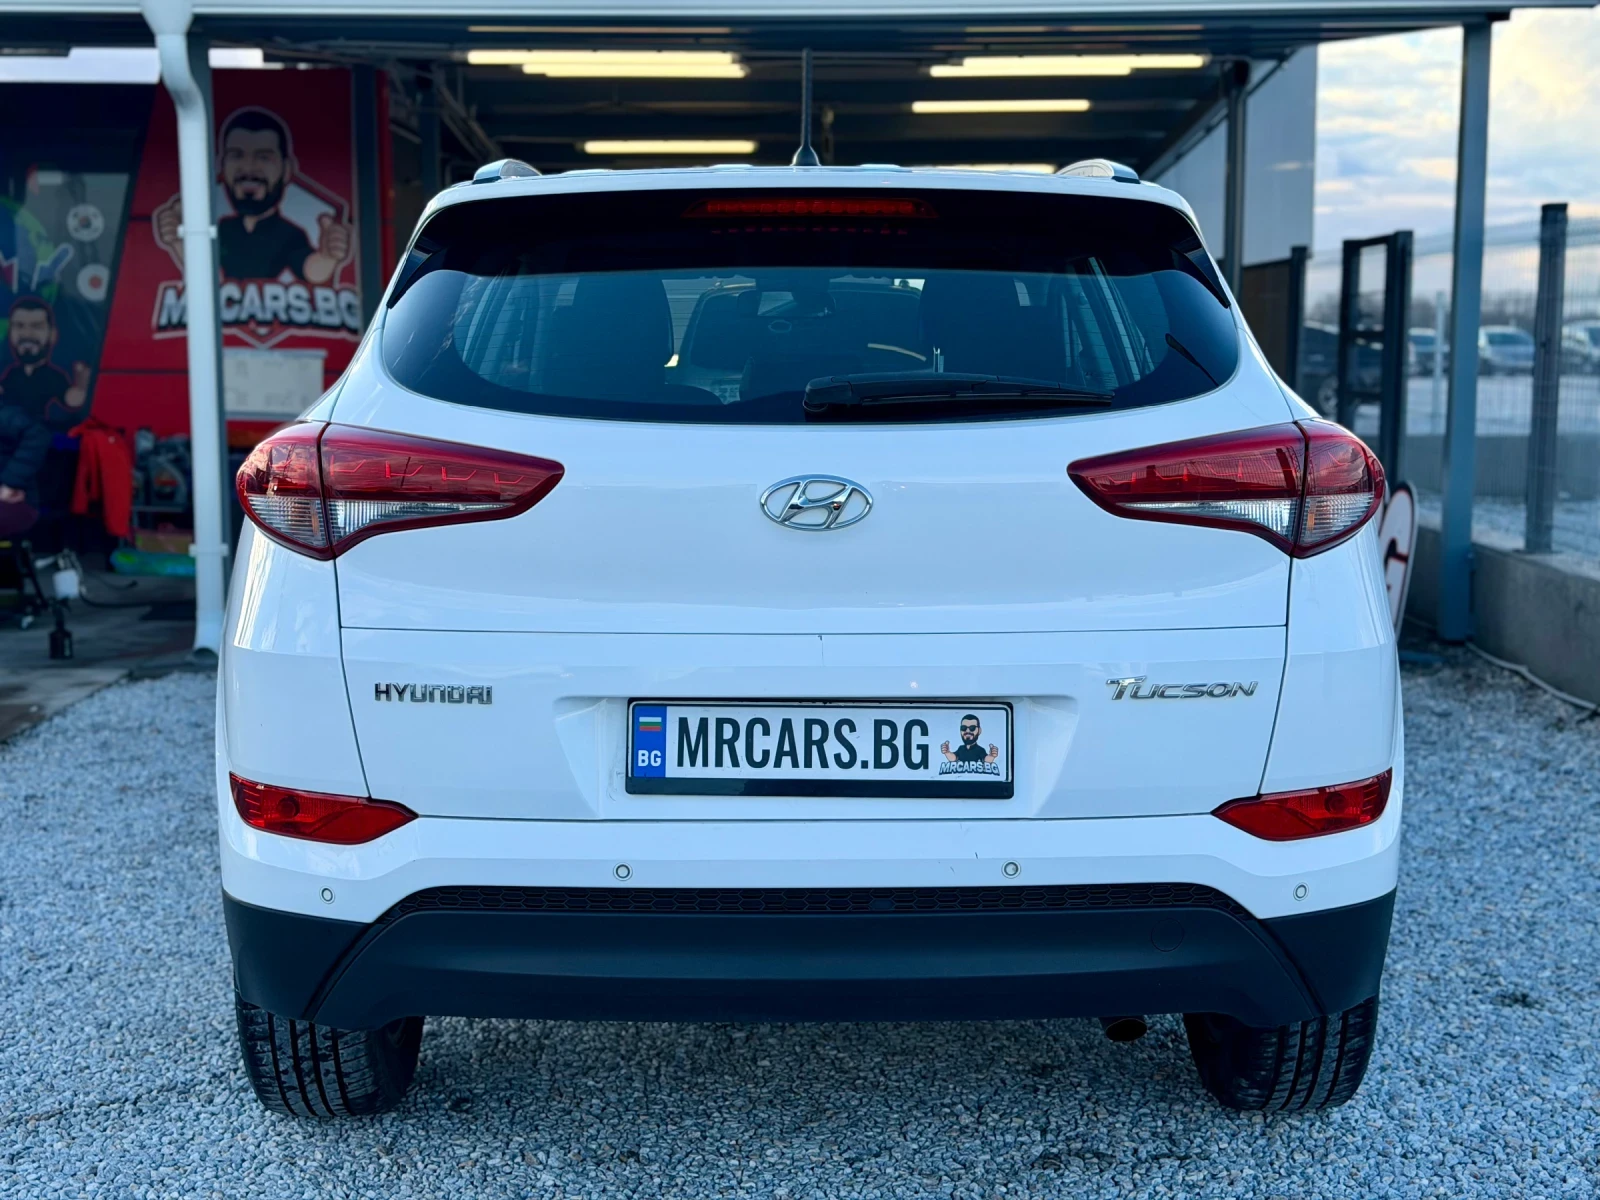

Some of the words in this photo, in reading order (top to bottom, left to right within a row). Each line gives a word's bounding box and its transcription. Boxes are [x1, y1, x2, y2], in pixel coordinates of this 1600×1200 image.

[159, 282, 362, 331] MCARS.BG
[374, 682, 493, 705] HYUNDAI
[1106, 675, 1259, 701] TUCSON
[676, 716, 930, 771] MRCARS.BG
[637, 749, 662, 767] BG
[939, 760, 1001, 776] MRCARS.BG
